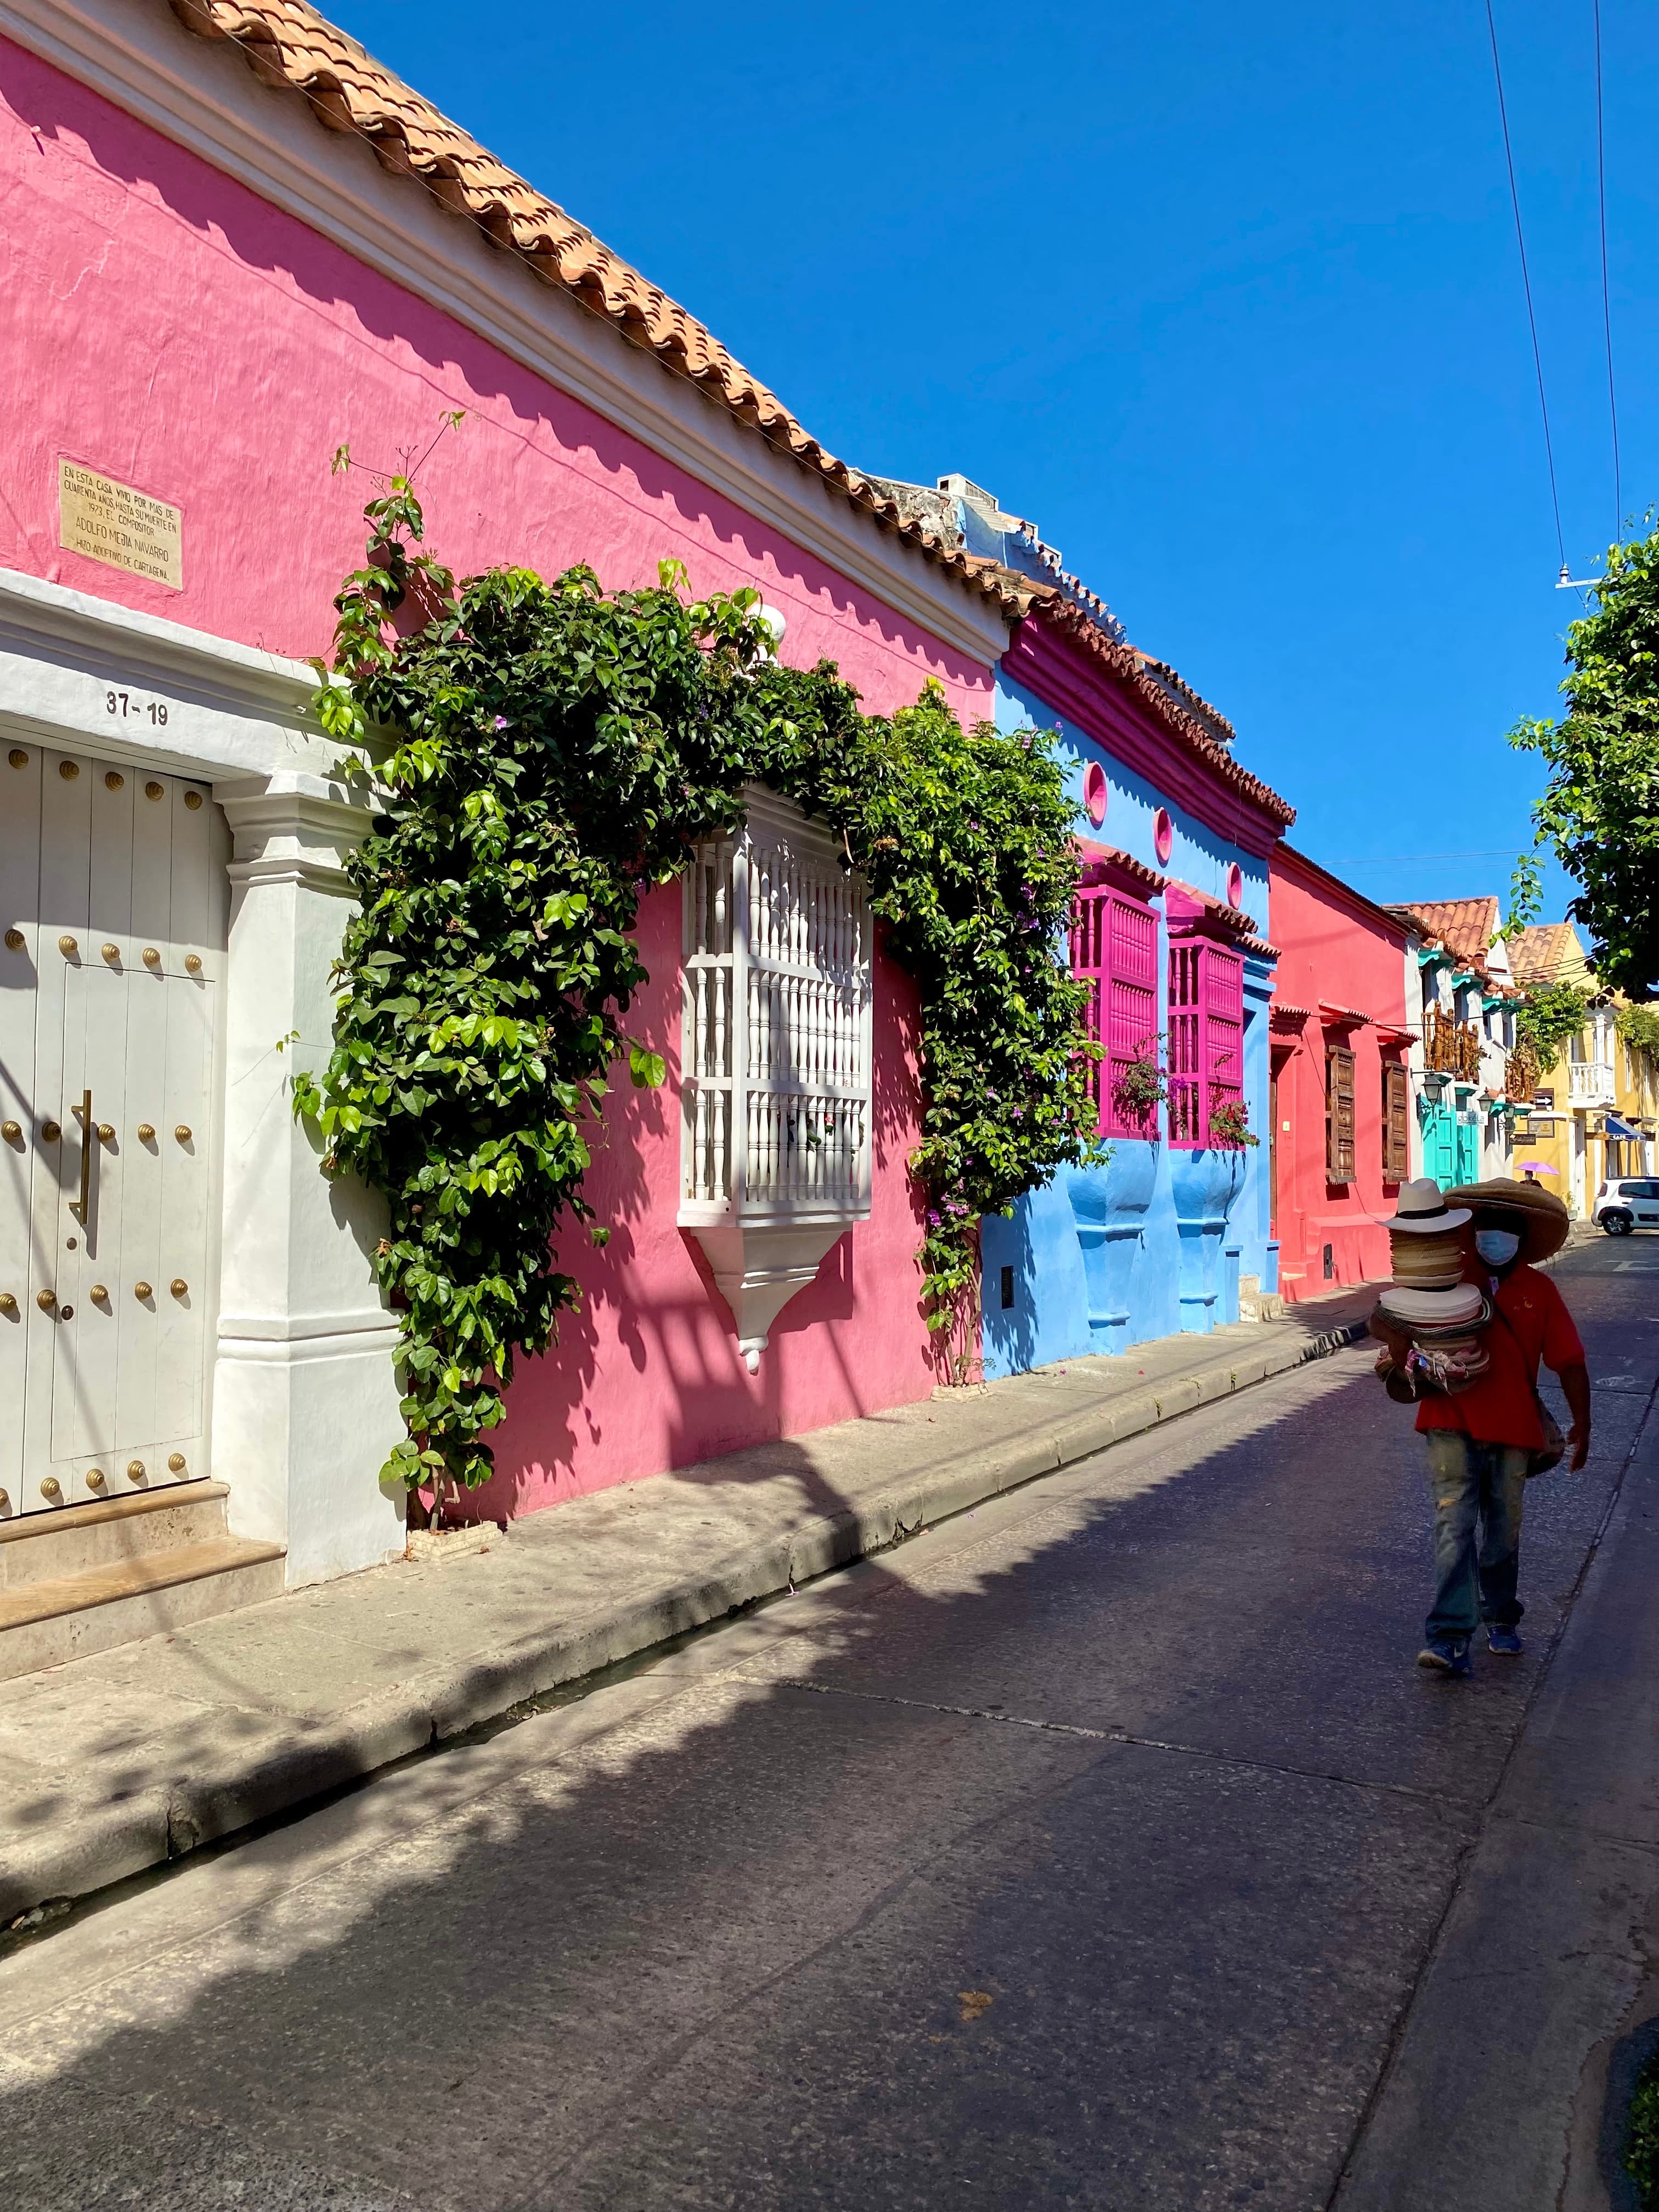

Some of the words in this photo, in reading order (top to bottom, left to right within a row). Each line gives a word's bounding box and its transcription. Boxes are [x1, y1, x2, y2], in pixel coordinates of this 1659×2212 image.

[64, 479, 96, 501] CUARENTA
[115, 500, 134, 516] HASTA
[136, 509, 143, 520] SU
[144, 512, 167, 530] MUERTE
[168, 522, 176, 534] EN
[65, 466, 74, 478] EN
[76, 471, 92, 487] ESTA
[97, 480, 112, 495] CASA
[134, 495, 146, 509] POR
[150, 502, 162, 516] MAS
[166, 509, 174, 520] DE
[76, 516, 107, 539] ADOLFO
[109, 529, 132, 549] MEJIA
[134, 539, 168, 562] NAVARRO
[88, 503, 105, 518] 1973,
[106, 509, 114, 521] EL
[119, 515, 154, 537] COMPOSITOR
[93, 545, 121, 563] ADOPTIVO
[123, 555, 132, 567] DE
